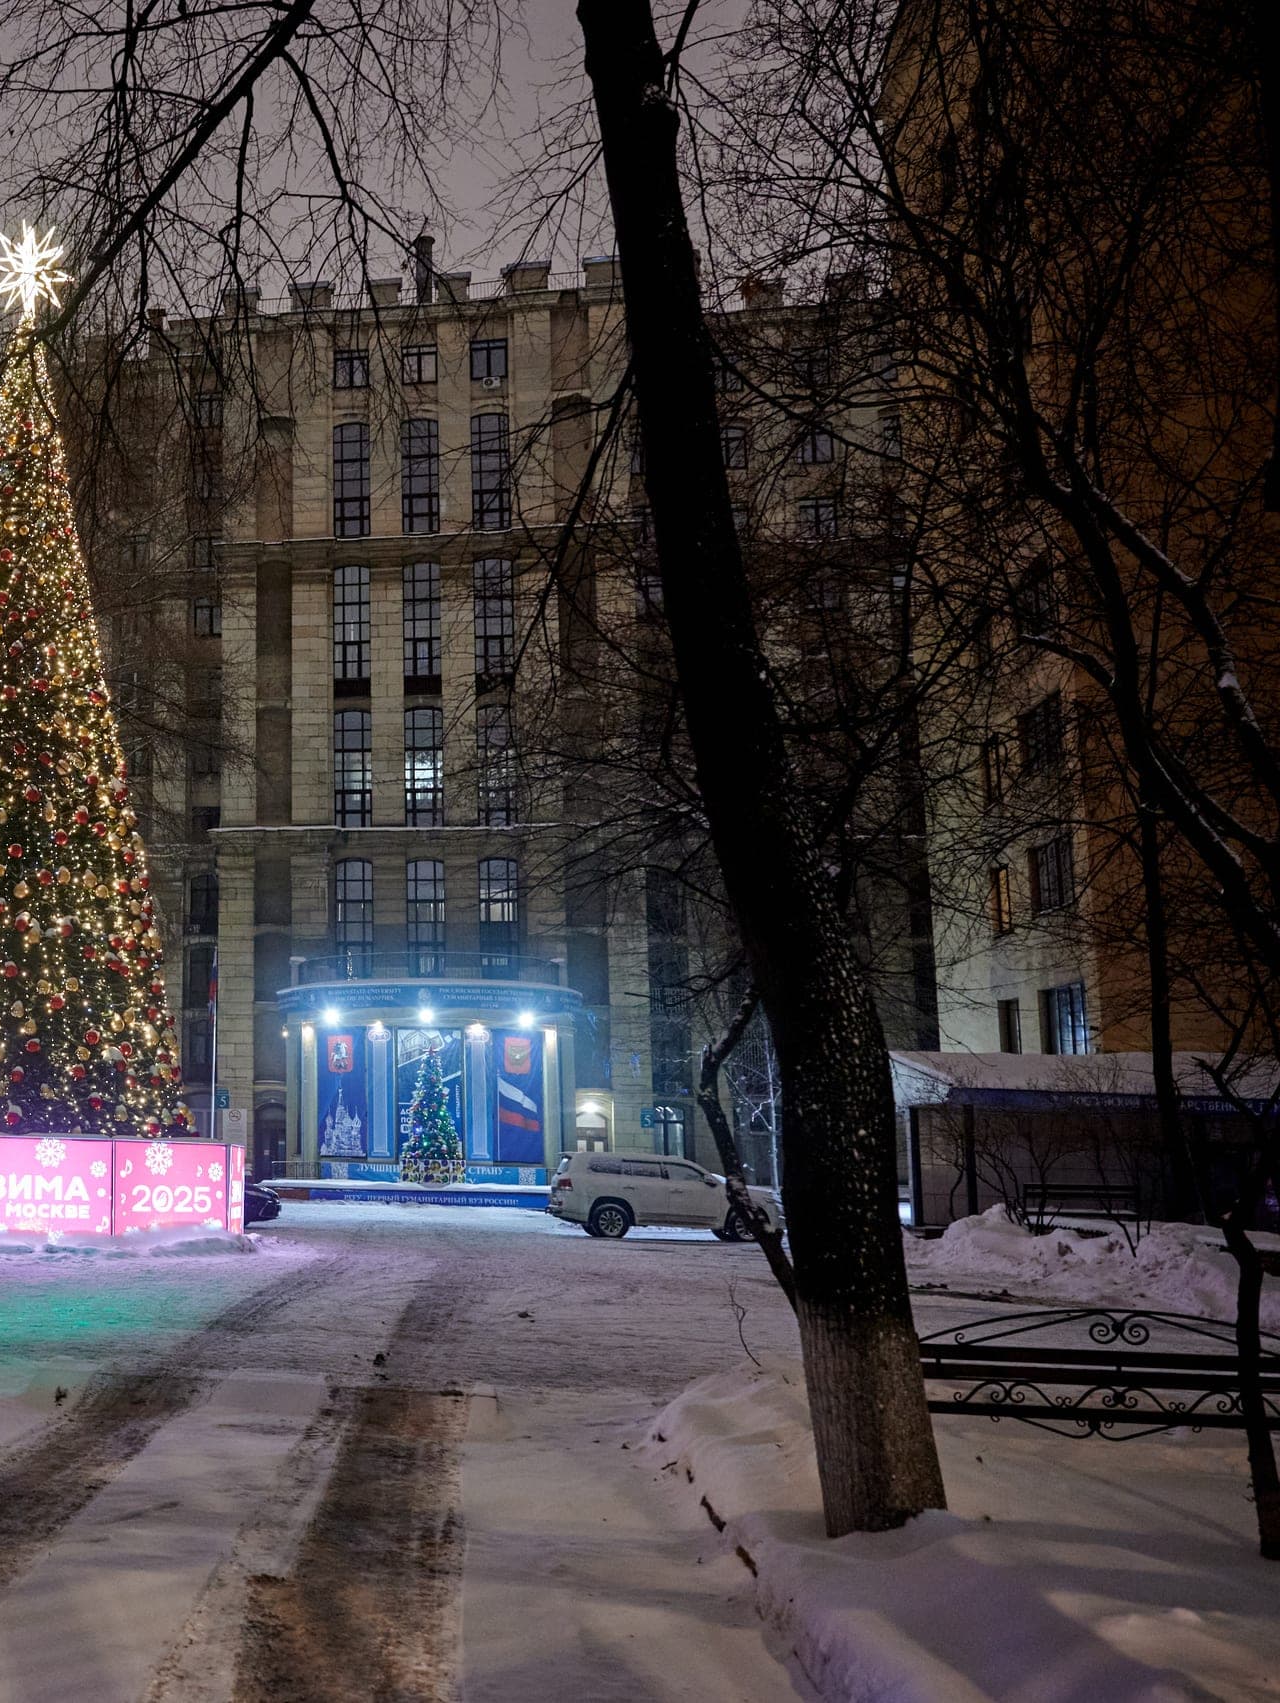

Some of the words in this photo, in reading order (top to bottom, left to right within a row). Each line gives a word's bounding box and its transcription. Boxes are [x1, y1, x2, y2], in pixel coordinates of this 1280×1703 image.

[643, 1114, 651, 1127] 5
[468, 1167, 503, 1176] СТРАНУ
[131, 1184, 212, 1213] 2025
[402, 1195, 466, 1205] ГУМАНИТАРНЫЙ
[468, 1197, 483, 1205] ВУЗ
[483, 1197, 519, 1206] РОССИИ!
[5, 1202, 90, 1219] МОСКВЕ
